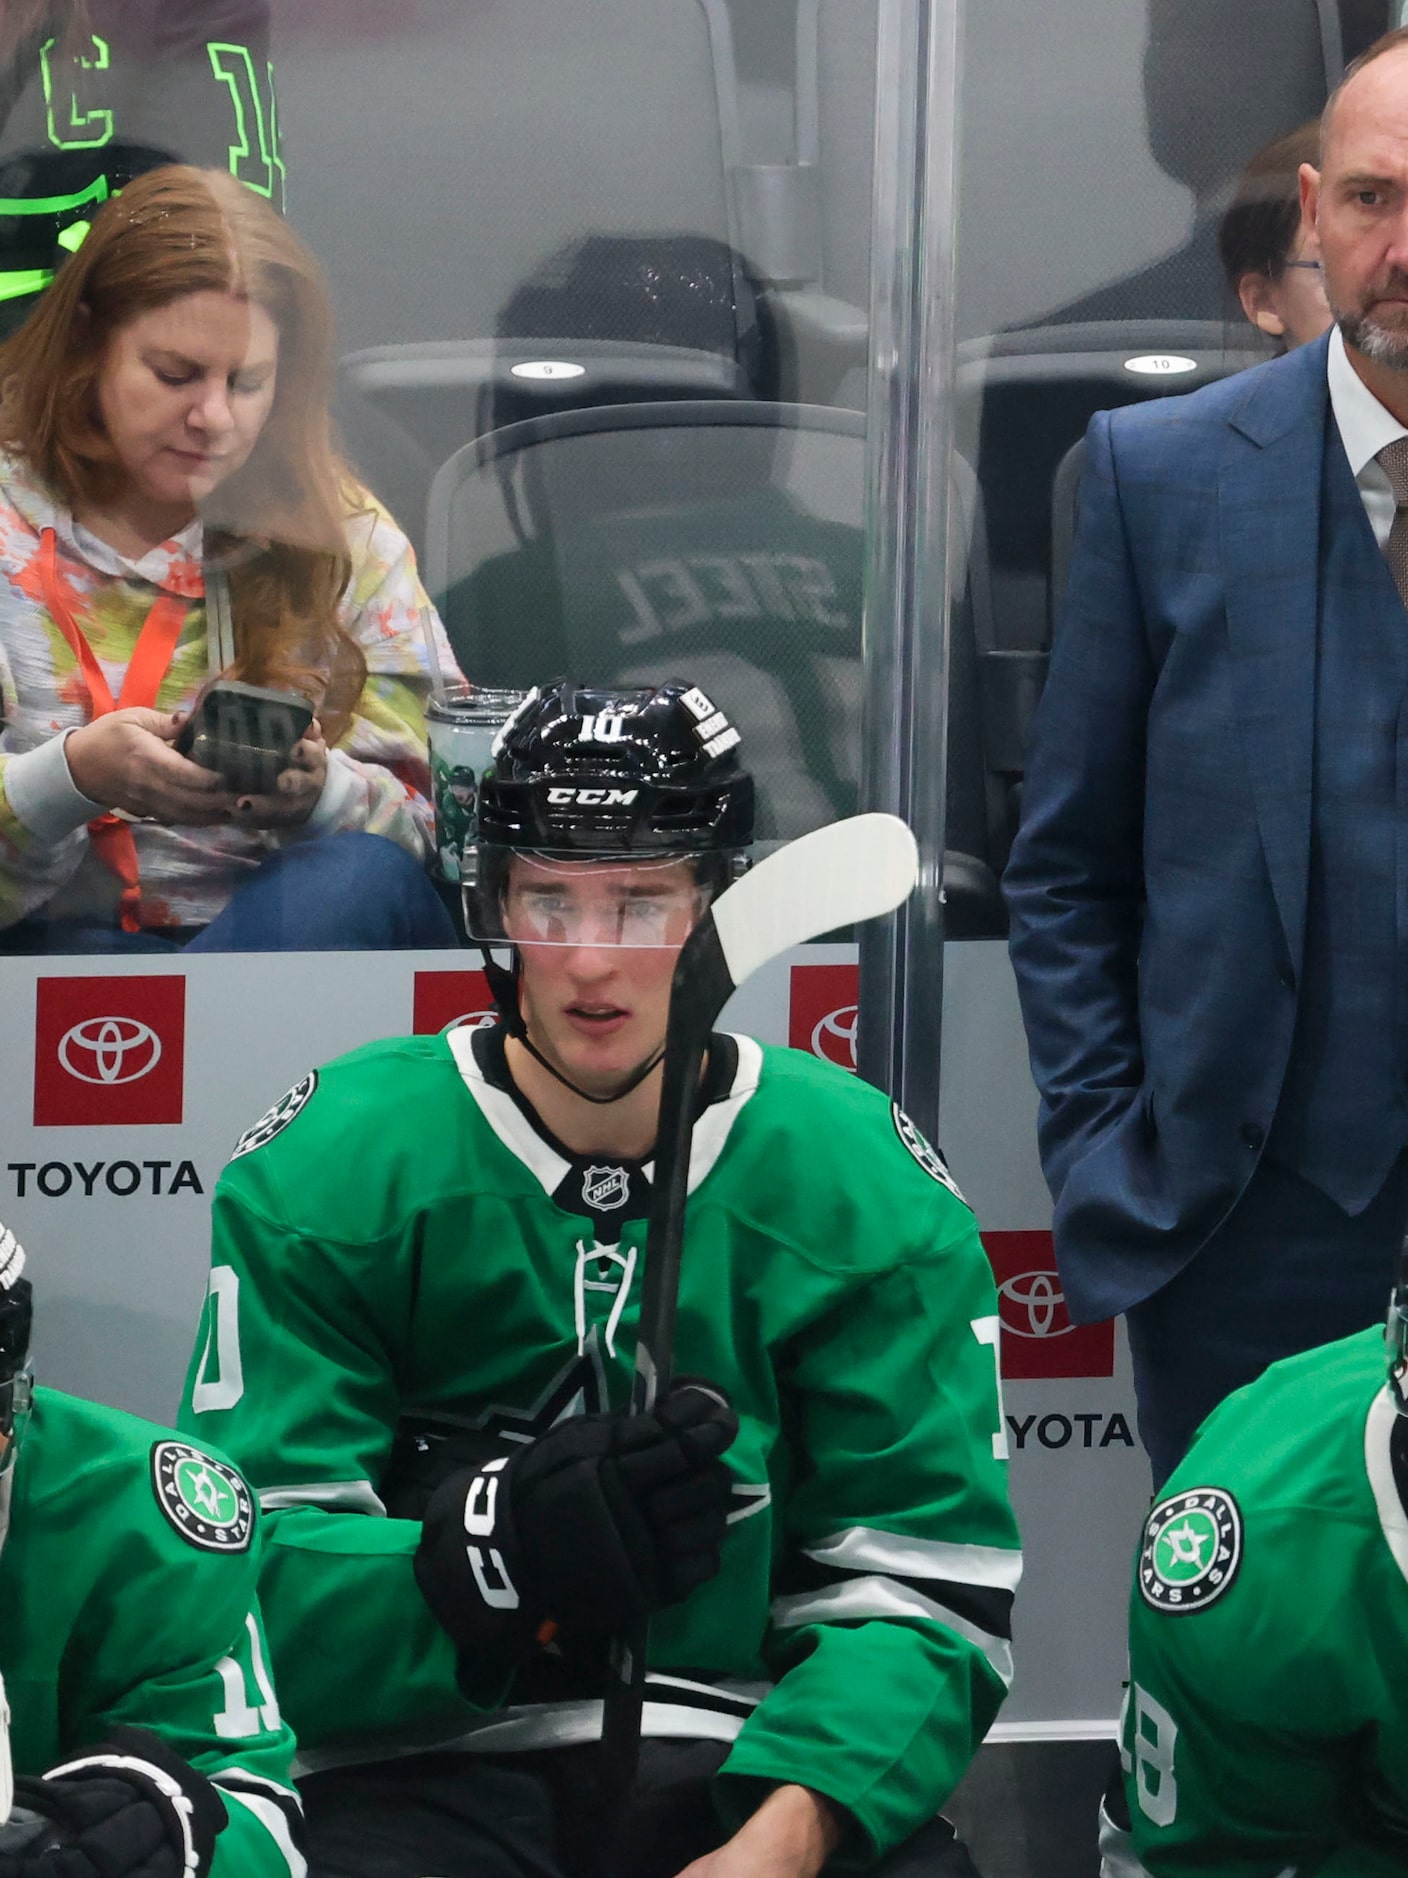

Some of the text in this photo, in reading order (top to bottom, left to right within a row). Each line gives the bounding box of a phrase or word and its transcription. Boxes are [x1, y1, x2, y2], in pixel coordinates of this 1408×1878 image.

[1152, 359, 1170, 369] 10
[578, 714, 623, 743] 10
[546, 787, 639, 806] CCM
[8, 1160, 204, 1197] TOYOTA
[592, 1178, 621, 1201] NHL
[192, 1264, 245, 1415] 0
[1005, 1413, 1135, 1449] YOTA
[463, 1457, 520, 1610] CC
